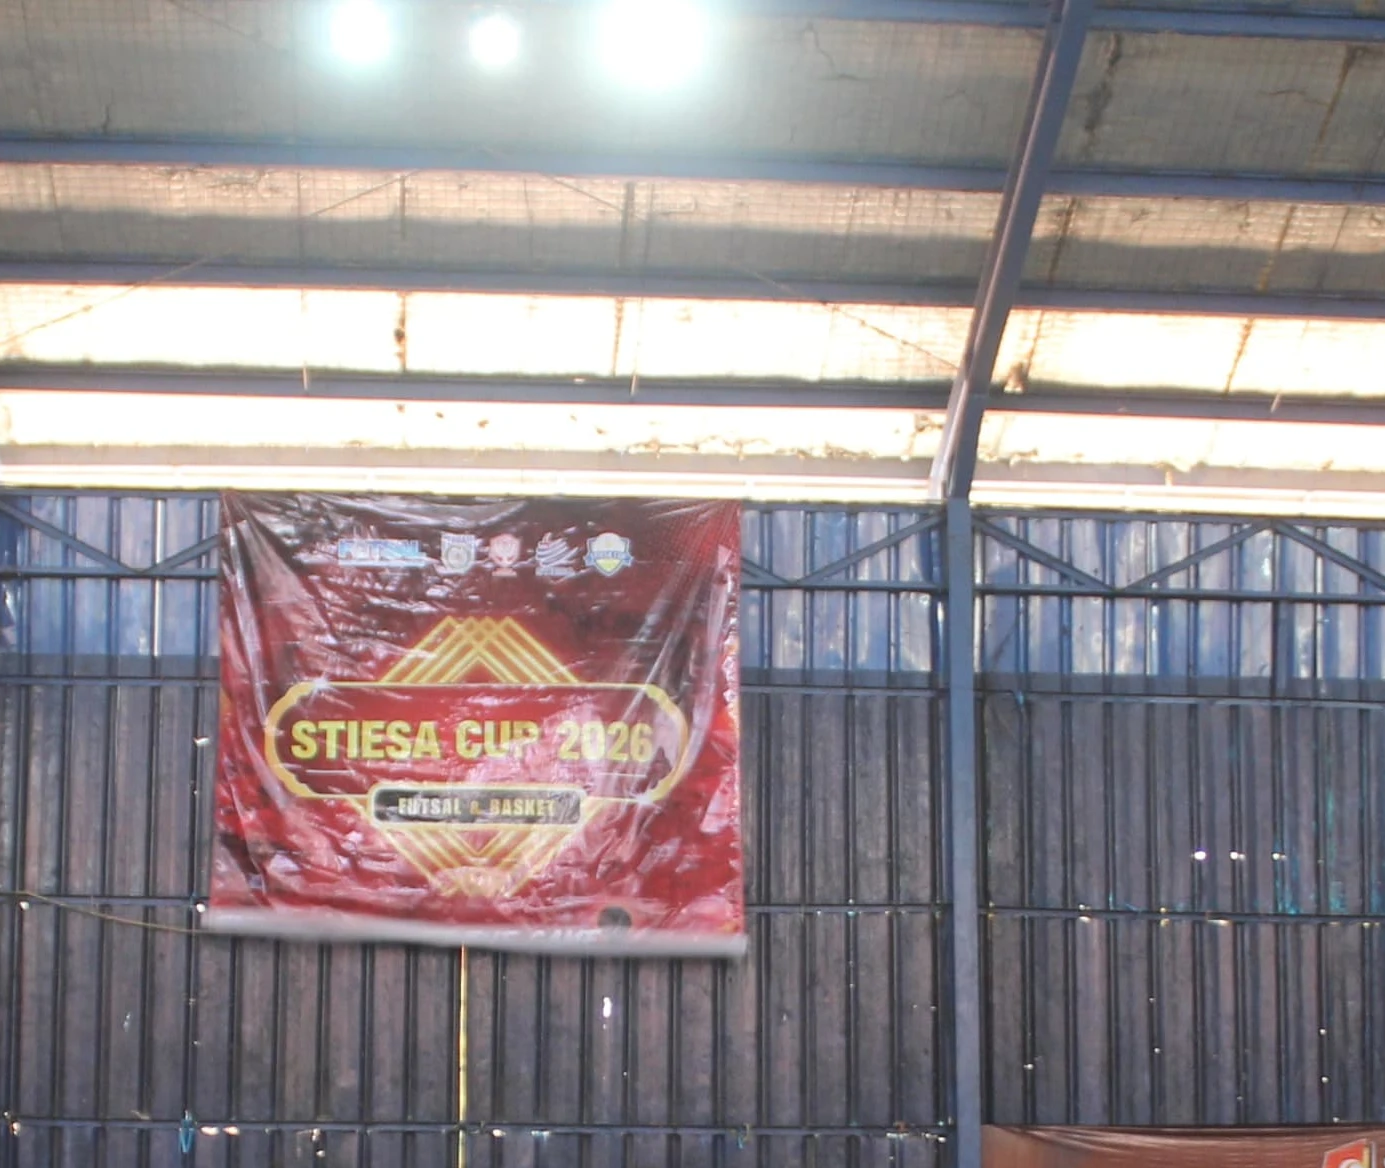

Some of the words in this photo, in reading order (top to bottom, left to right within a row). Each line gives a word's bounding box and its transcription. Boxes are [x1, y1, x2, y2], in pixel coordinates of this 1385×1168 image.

[290, 720, 442, 760] STIESA
[455, 720, 539, 760] CUP
[557, 722, 654, 762] 2026
[398, 797, 461, 816] FUTSAL
[489, 799, 555, 817] BASKET
